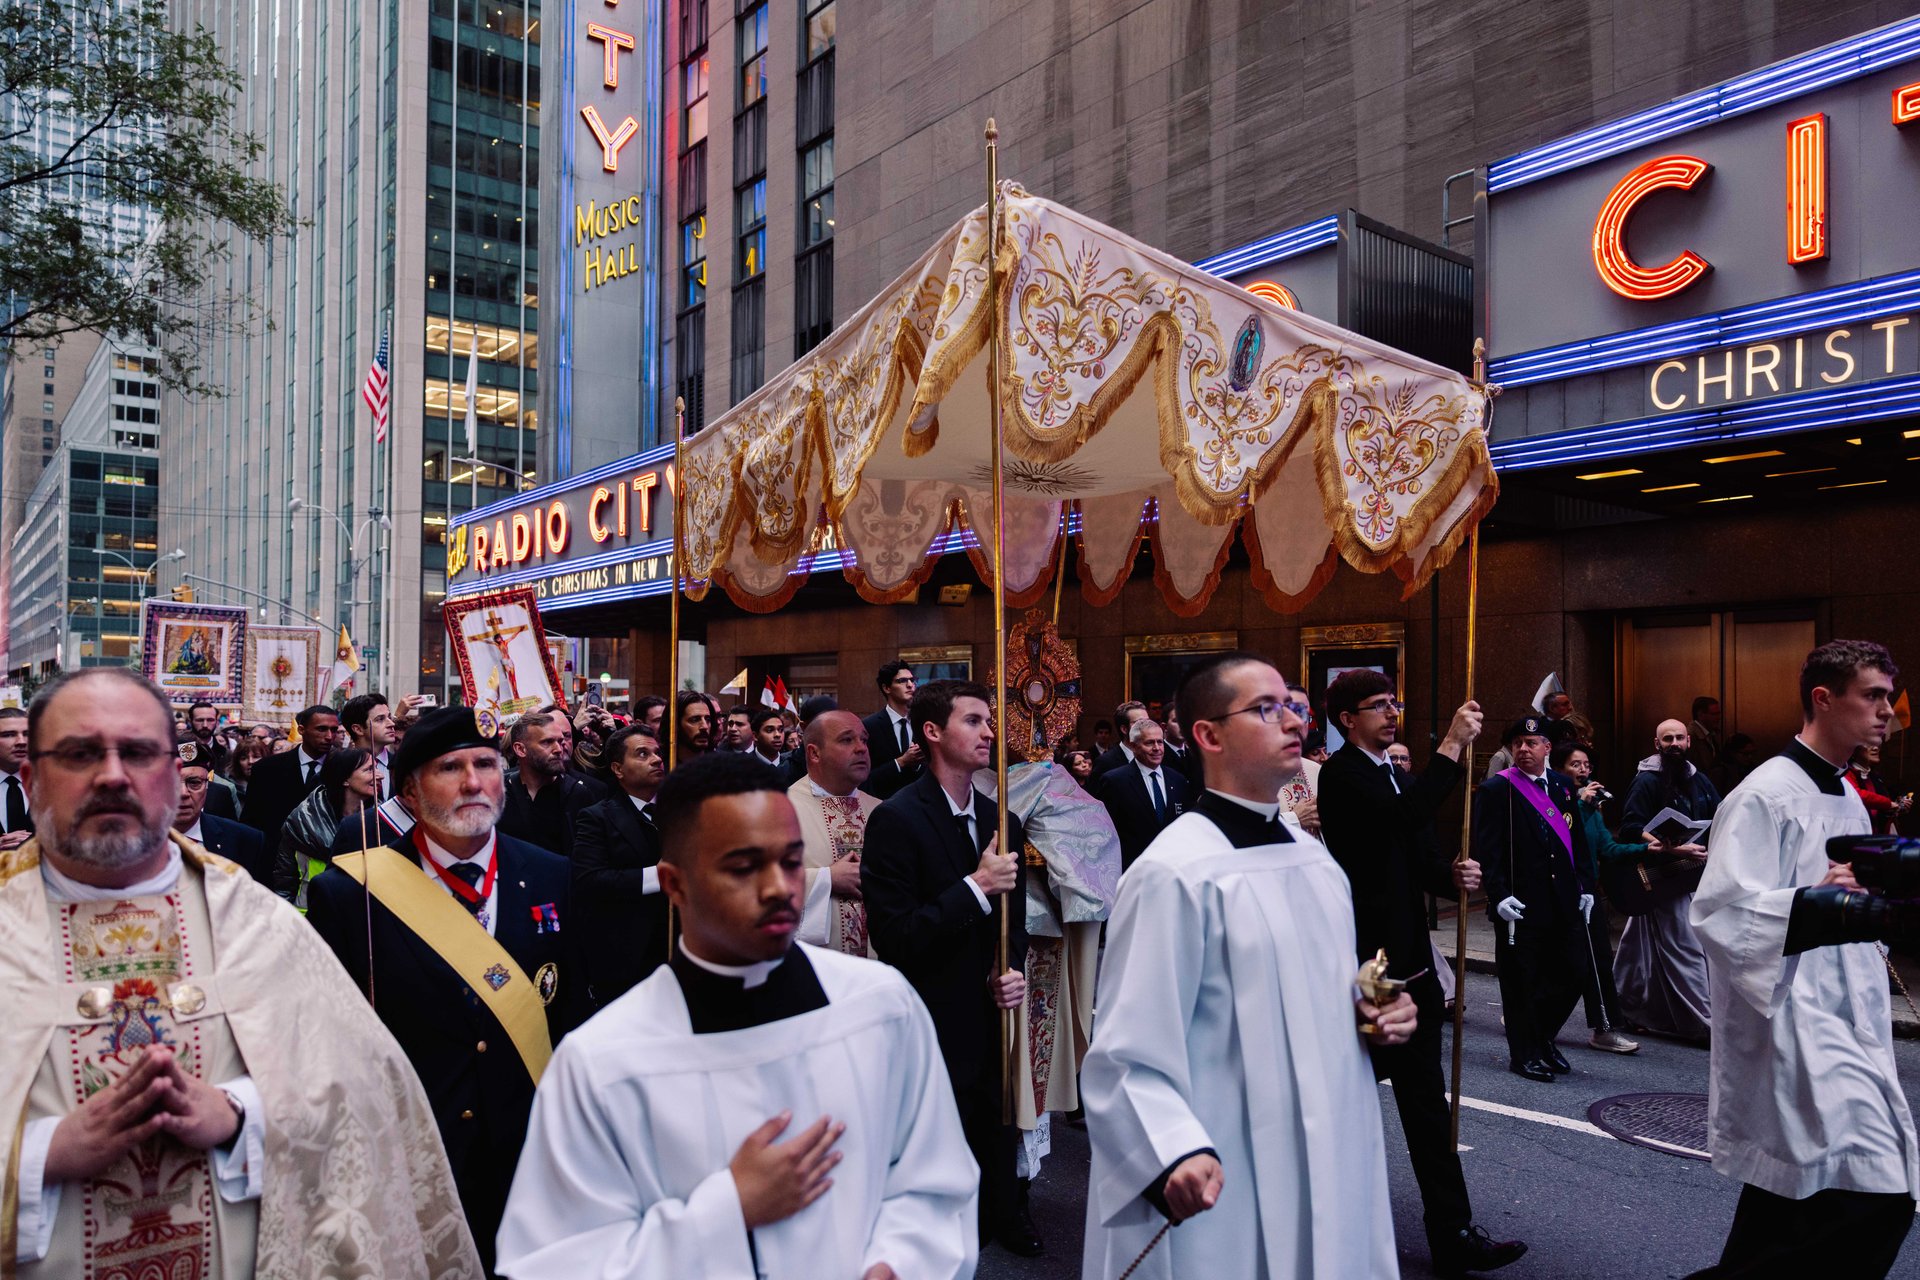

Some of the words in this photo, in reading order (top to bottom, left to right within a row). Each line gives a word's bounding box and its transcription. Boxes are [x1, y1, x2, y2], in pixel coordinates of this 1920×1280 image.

[581, 0, 639, 172] TY
[575, 195, 640, 247] MUSIC
[584, 243, 639, 292] HALL
[1650, 317, 1910, 411] CHRIST
[473, 500, 567, 573] RADIO
[537, 578, 547, 598] IS
[551, 567, 609, 596] CHRISTMAS
[615, 561, 627, 584] IN
[632, 557, 659, 583] NEW
